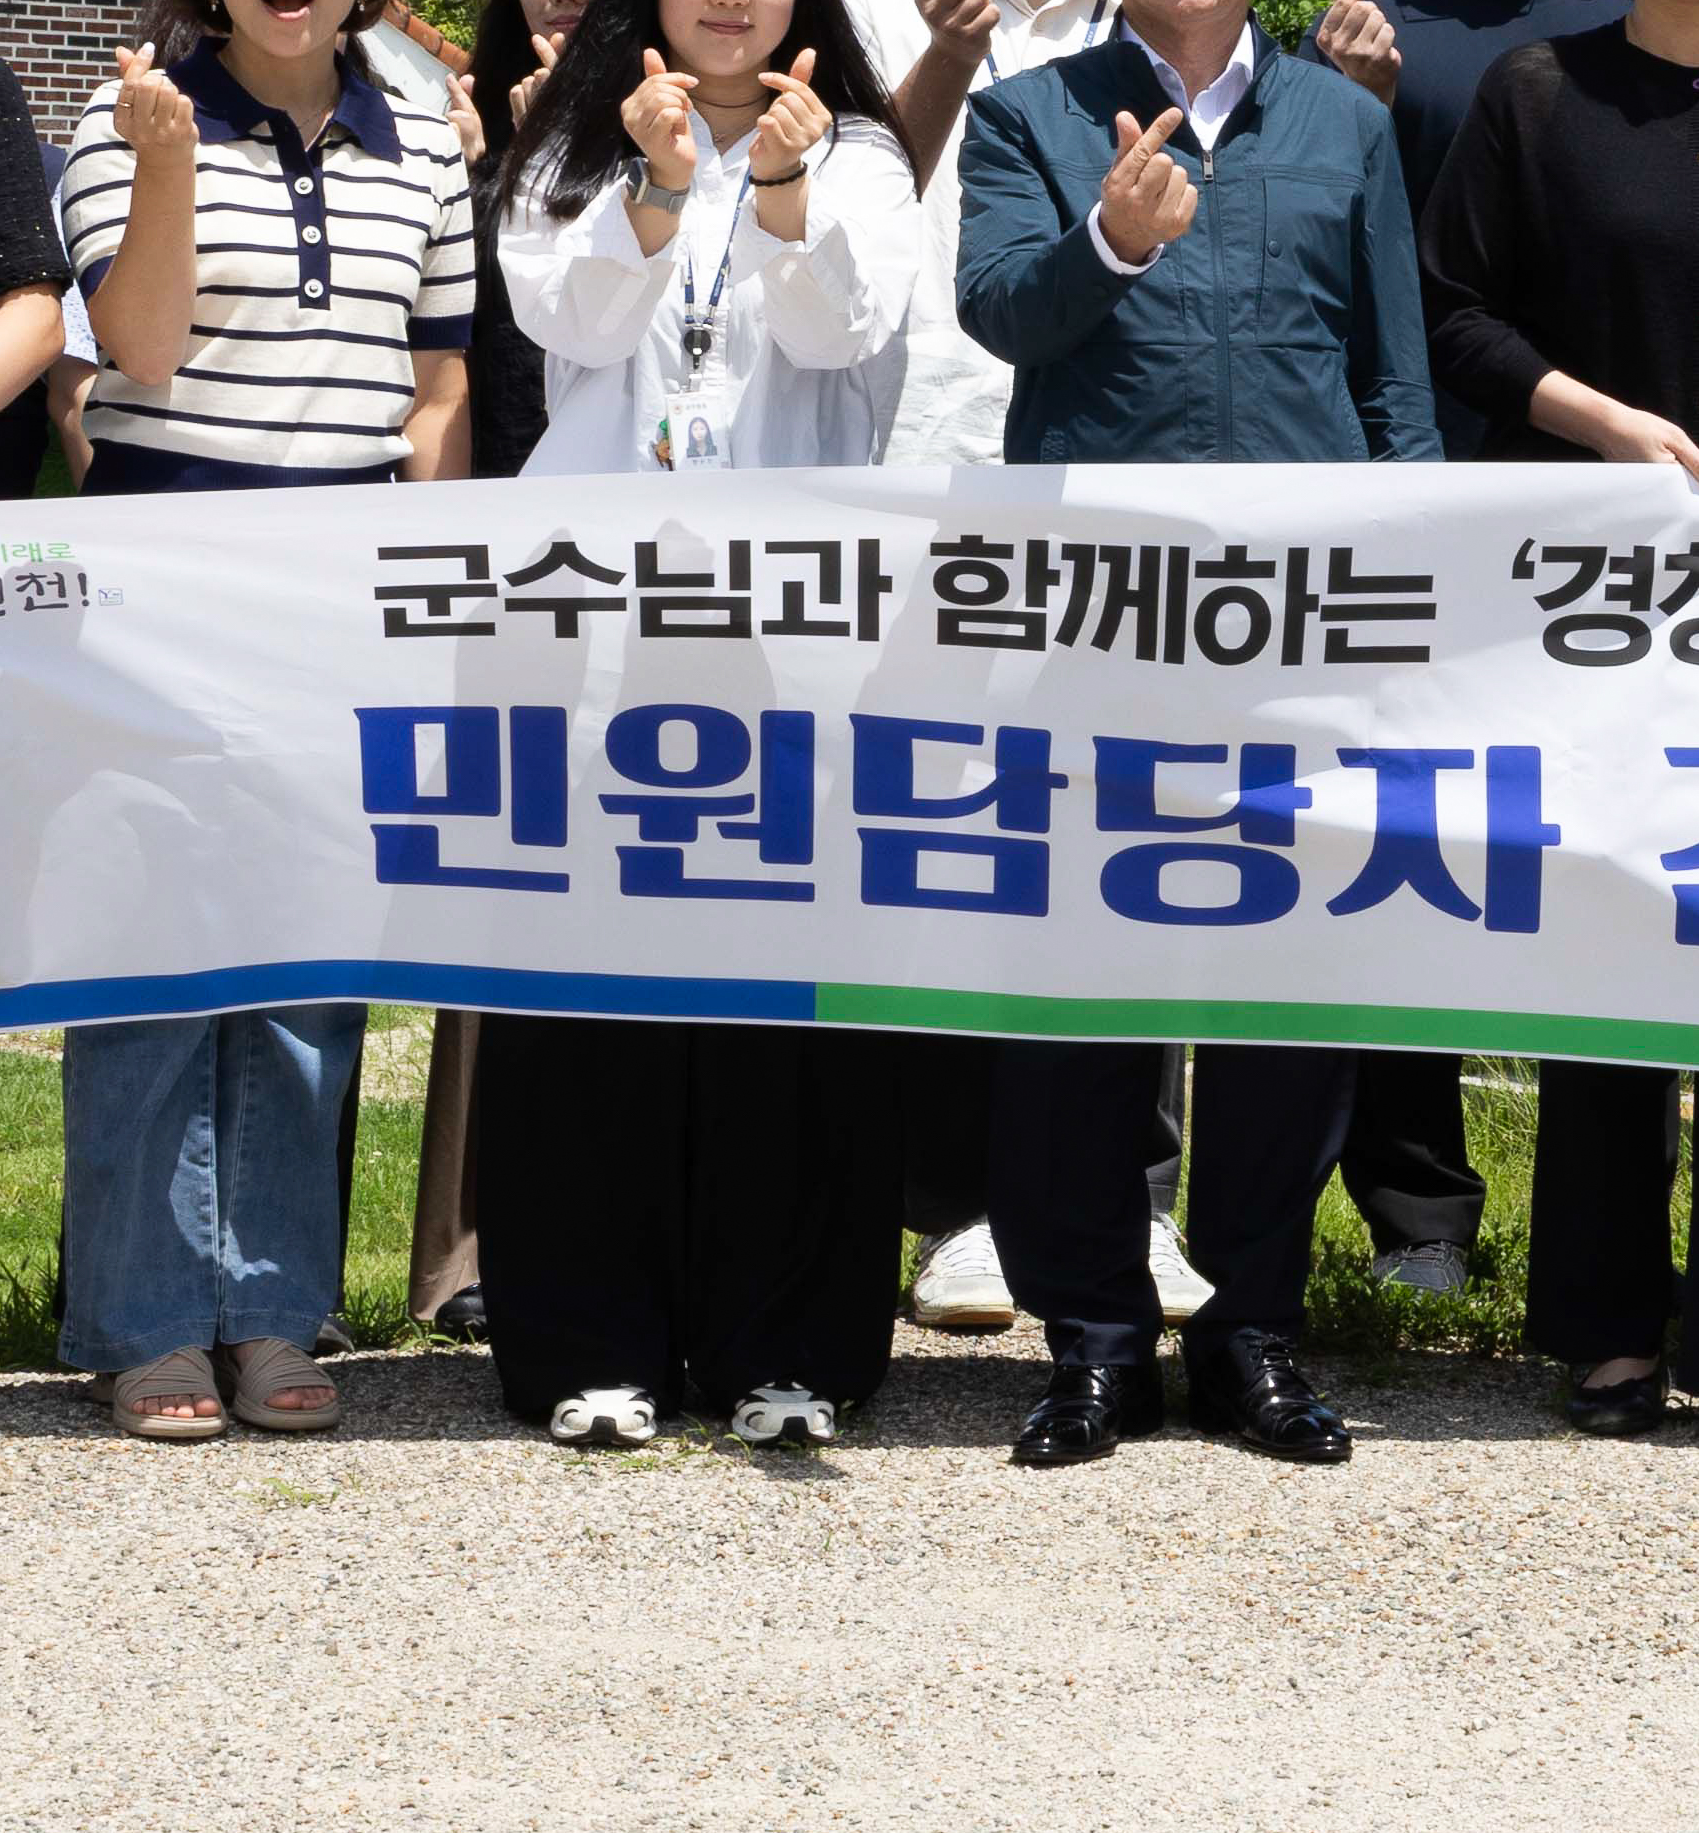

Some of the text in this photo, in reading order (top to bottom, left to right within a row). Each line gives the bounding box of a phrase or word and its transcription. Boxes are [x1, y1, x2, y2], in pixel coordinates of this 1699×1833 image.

[373, 537, 893, 643] 군수님과
[929, 534, 1437, 667] 함께하는
[353, 702, 1562, 934] 민원담당자
